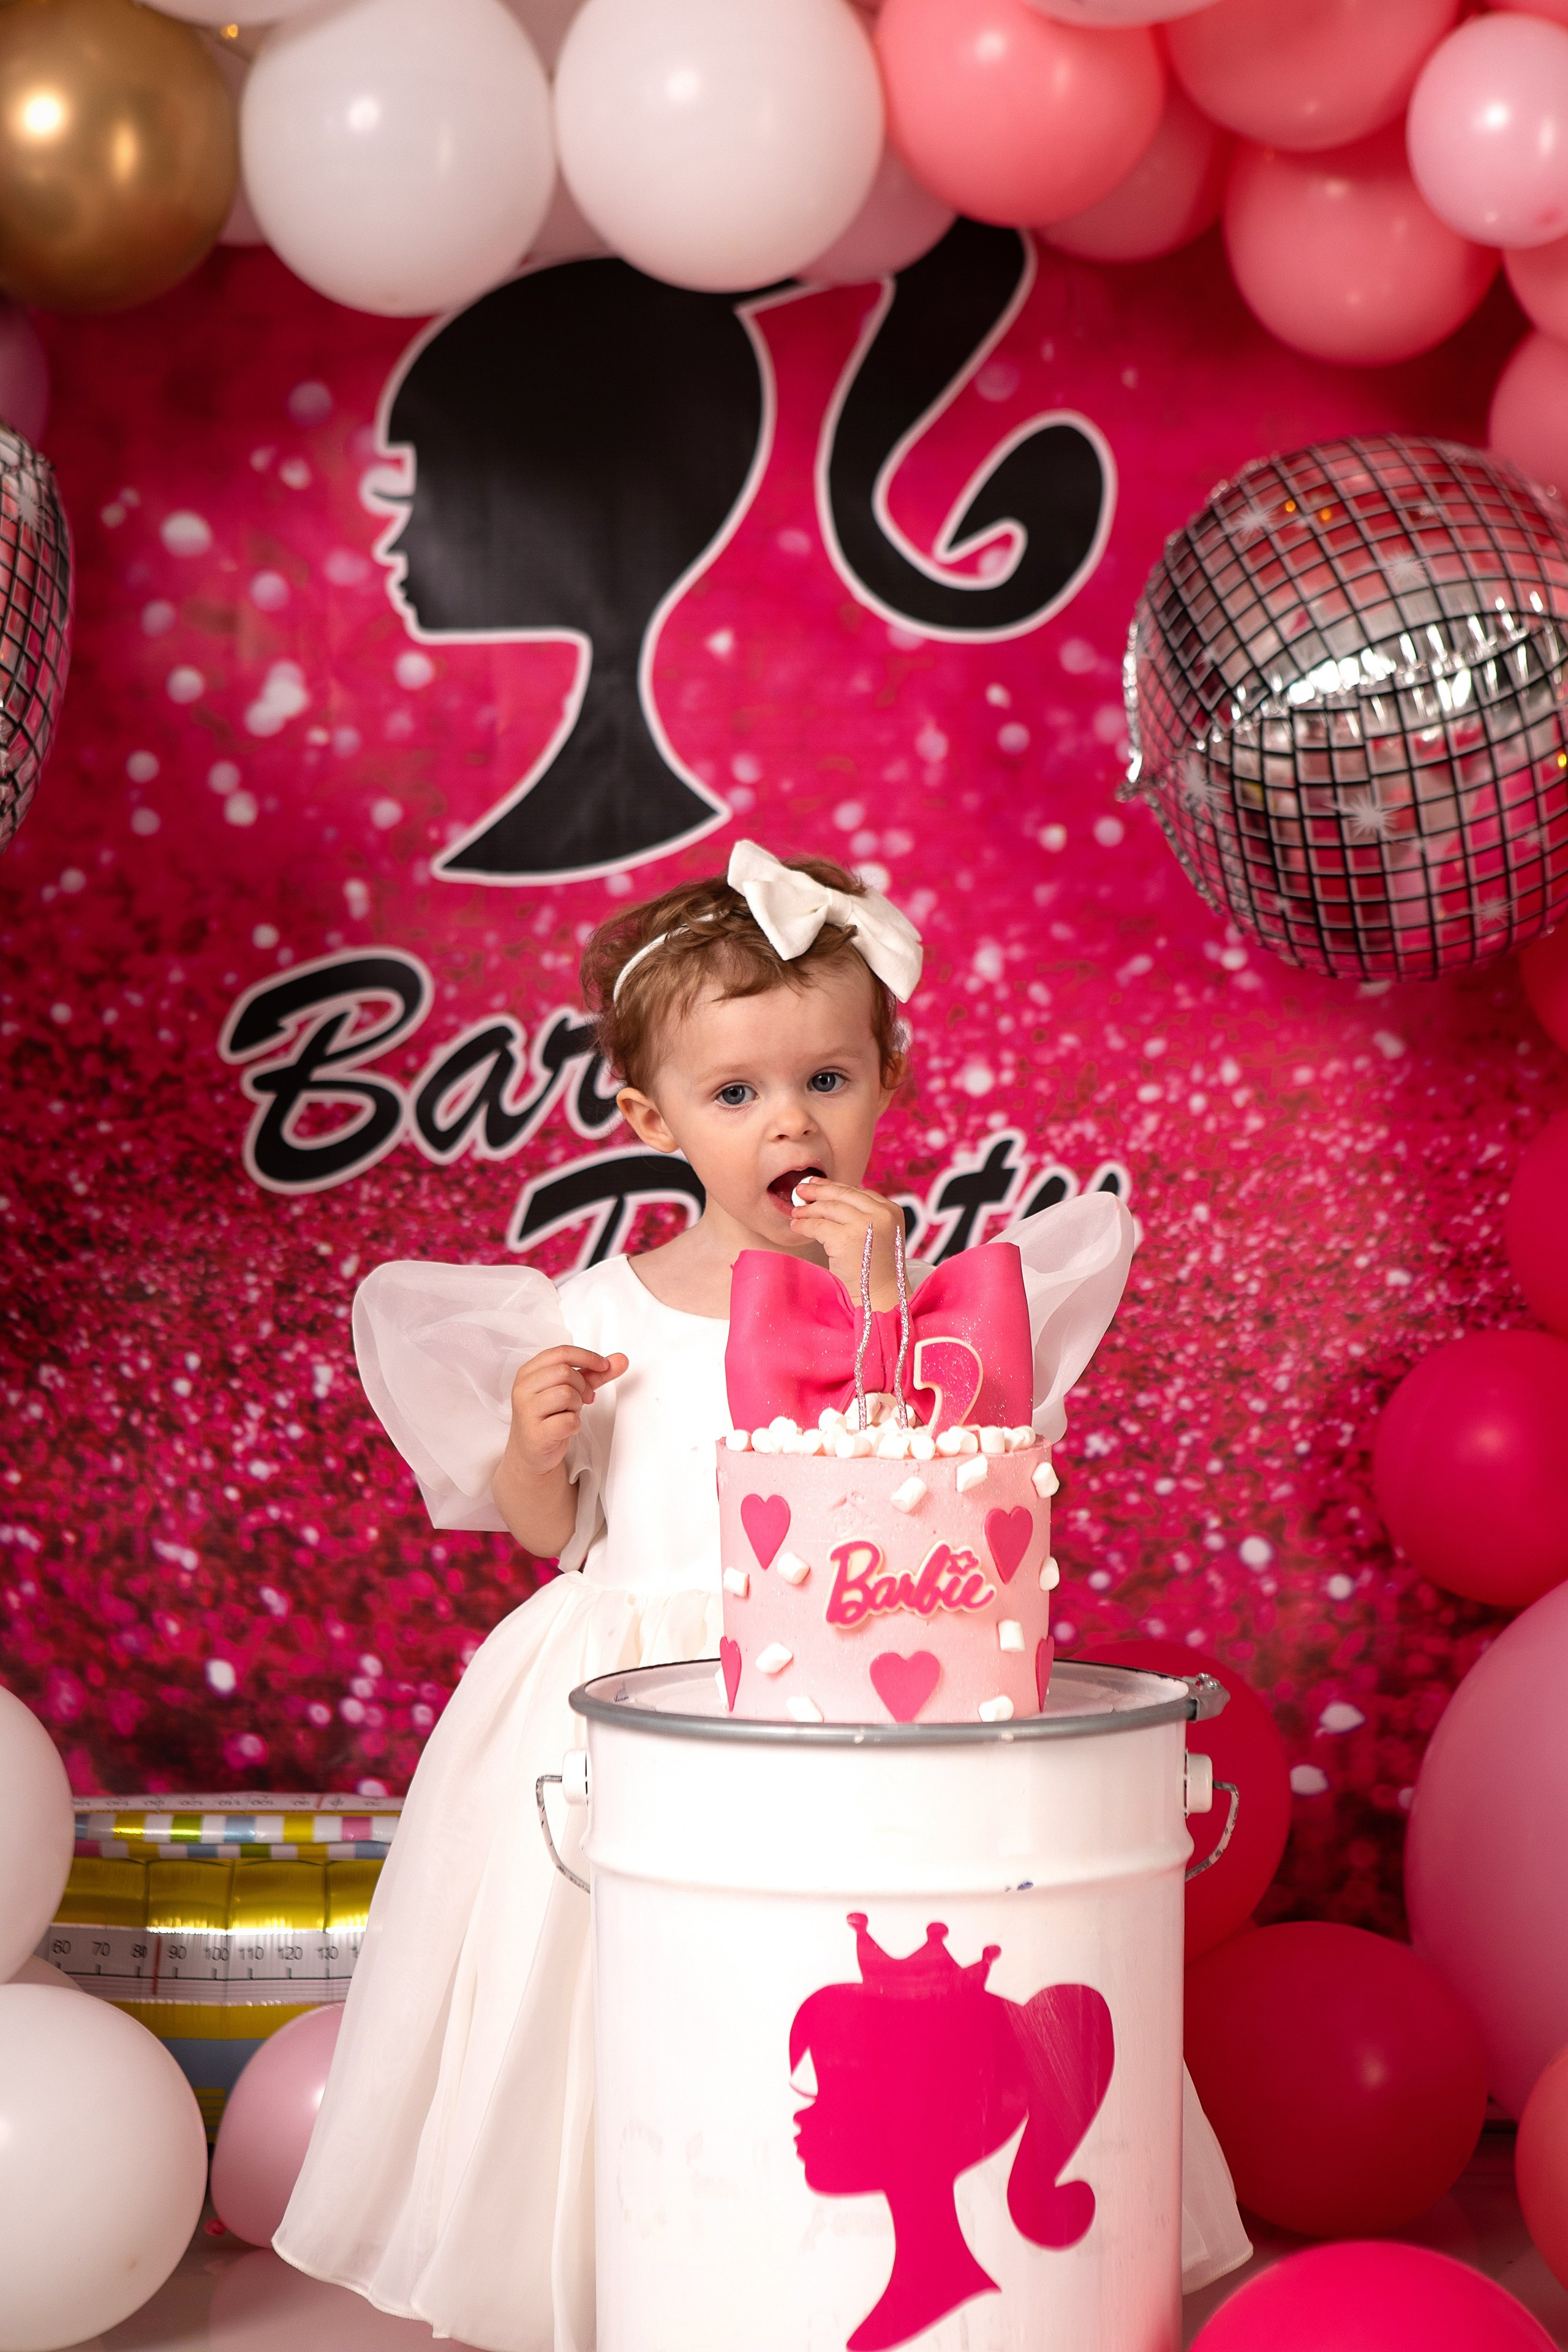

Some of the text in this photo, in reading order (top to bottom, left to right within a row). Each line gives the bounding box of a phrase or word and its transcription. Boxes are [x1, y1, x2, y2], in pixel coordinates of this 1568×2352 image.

[219, 948, 624, 1193] Bar
[824, 1539, 996, 1627] Barbie
[53, 1939, 72, 1954] 60
[93, 1941, 111, 1957] 70
[132, 1943, 148, 1959] 80
[168, 1944, 187, 1959] 90
[205, 1946, 230, 1961] 100
[239, 1946, 265, 1961] 110
[278, 1945, 304, 1960] 120
